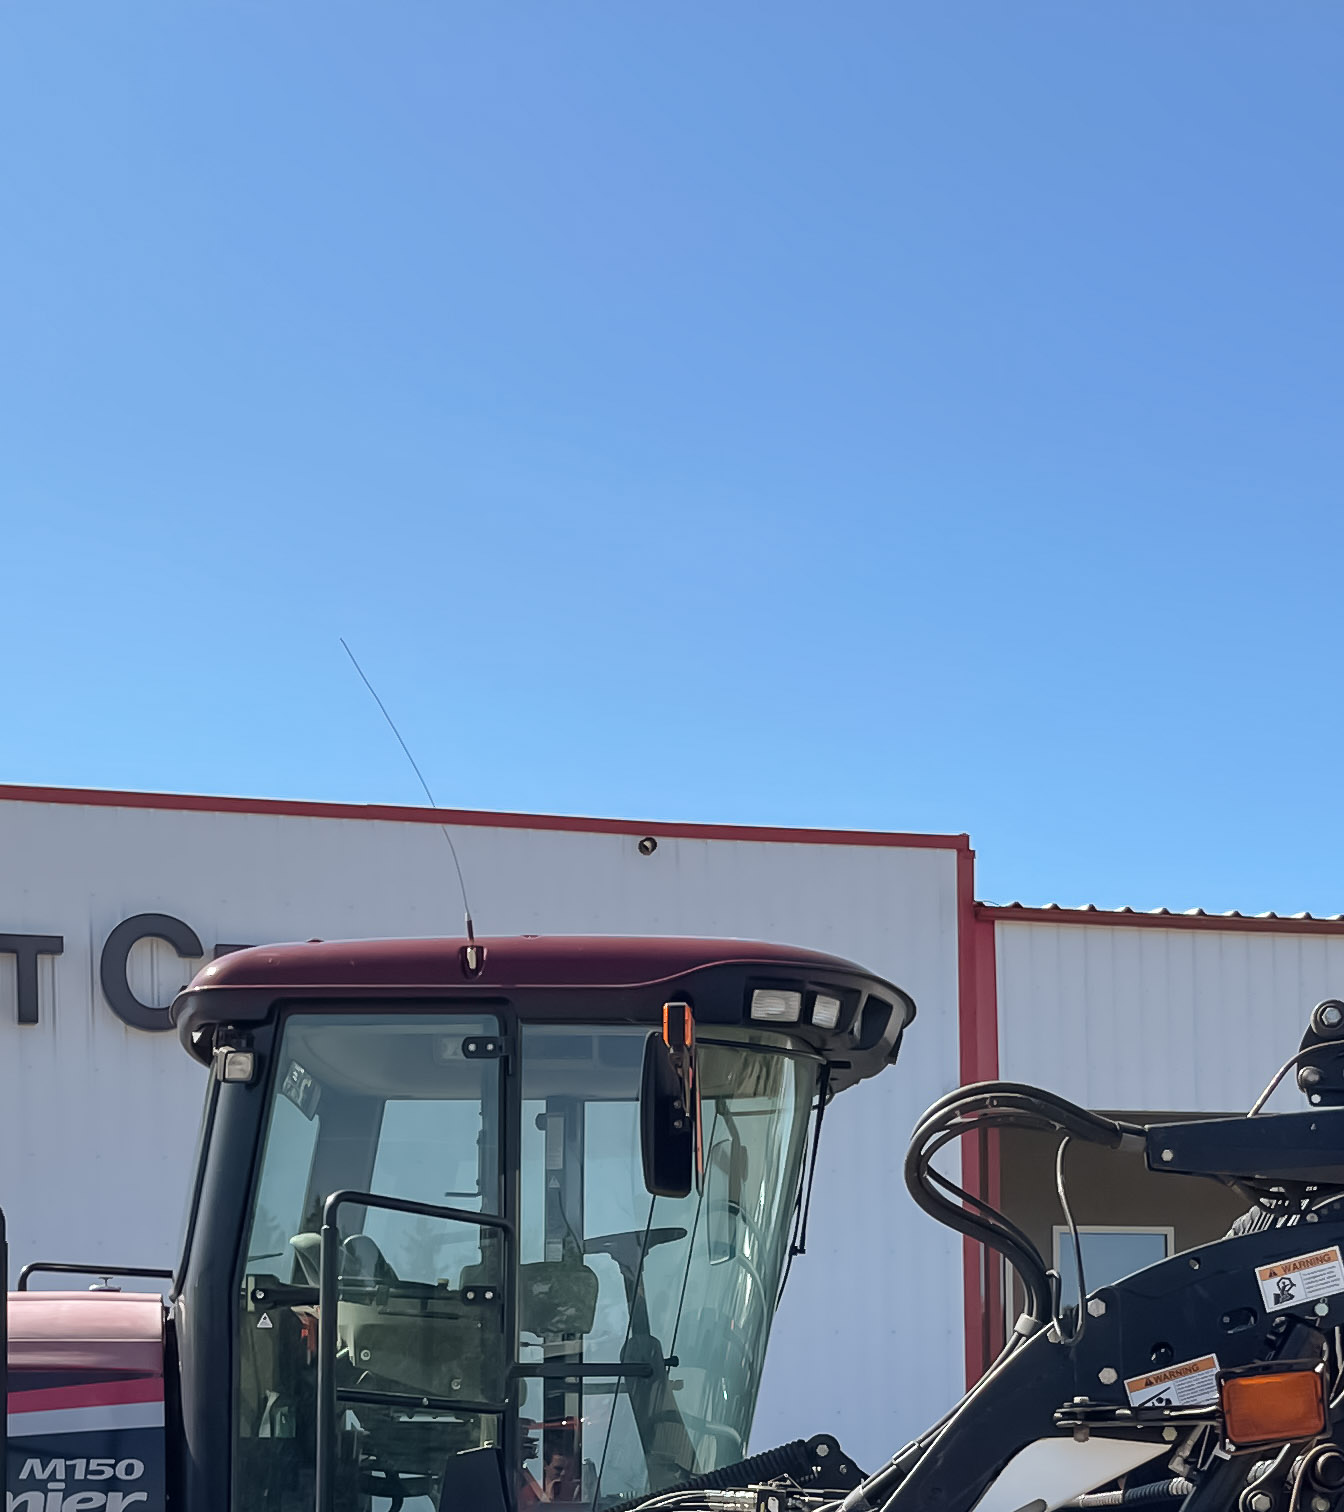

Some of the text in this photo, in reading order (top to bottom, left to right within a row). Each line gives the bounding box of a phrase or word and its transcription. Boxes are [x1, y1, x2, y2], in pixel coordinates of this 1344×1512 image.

[1281, 1253, 1331, 1275] WARNING
[1153, 1364, 1200, 1384] WARNING
[19, 1458, 145, 1481] M150
